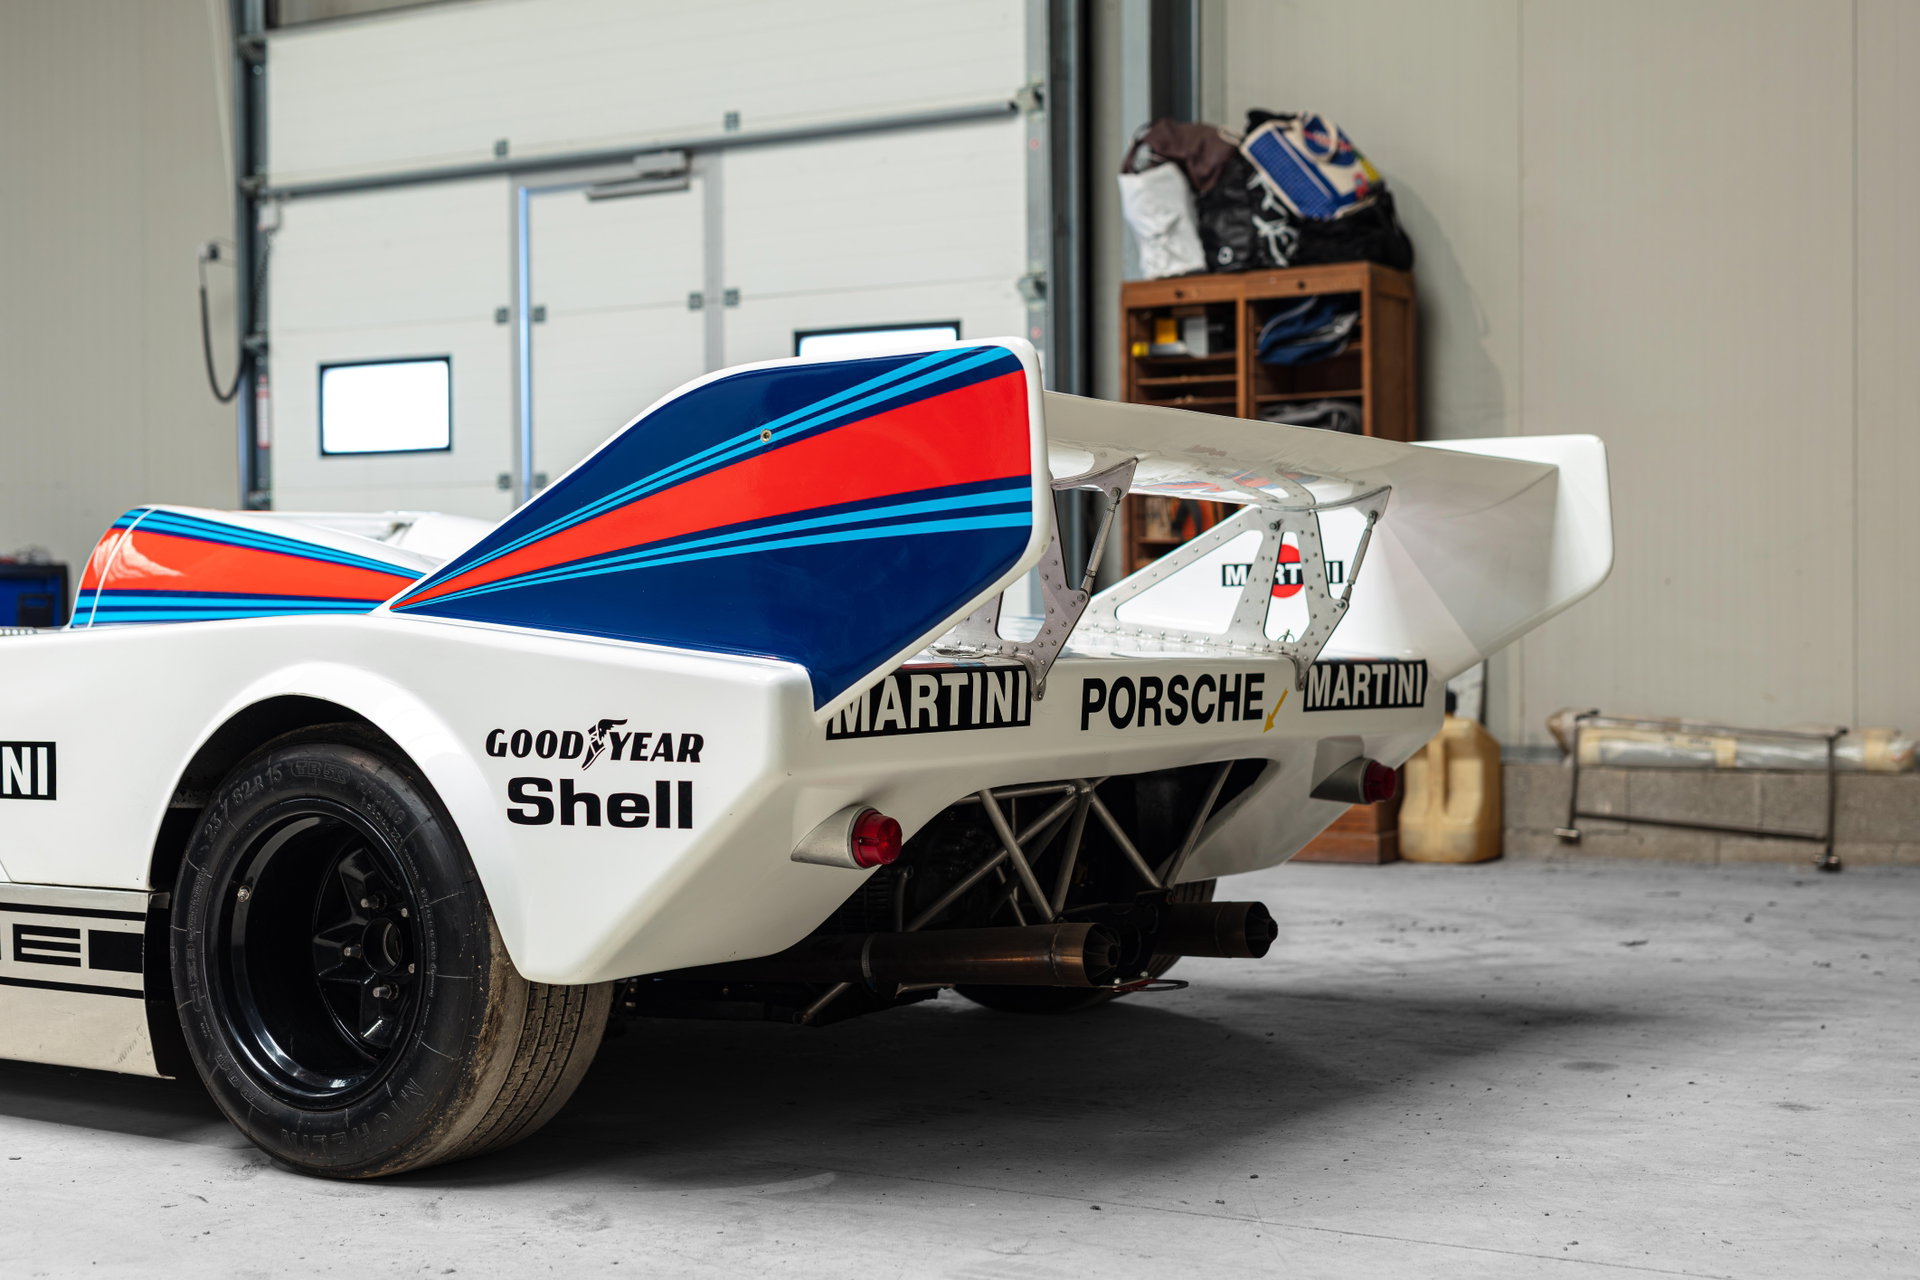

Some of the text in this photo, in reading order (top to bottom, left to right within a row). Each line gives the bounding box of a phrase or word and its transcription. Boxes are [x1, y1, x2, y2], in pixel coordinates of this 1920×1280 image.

[831, 670, 1028, 735] MARTINI
[1080, 672, 1265, 731] PORSCHE
[1306, 663, 1425, 709] MARTINI
[507, 777, 693, 829] Shell
